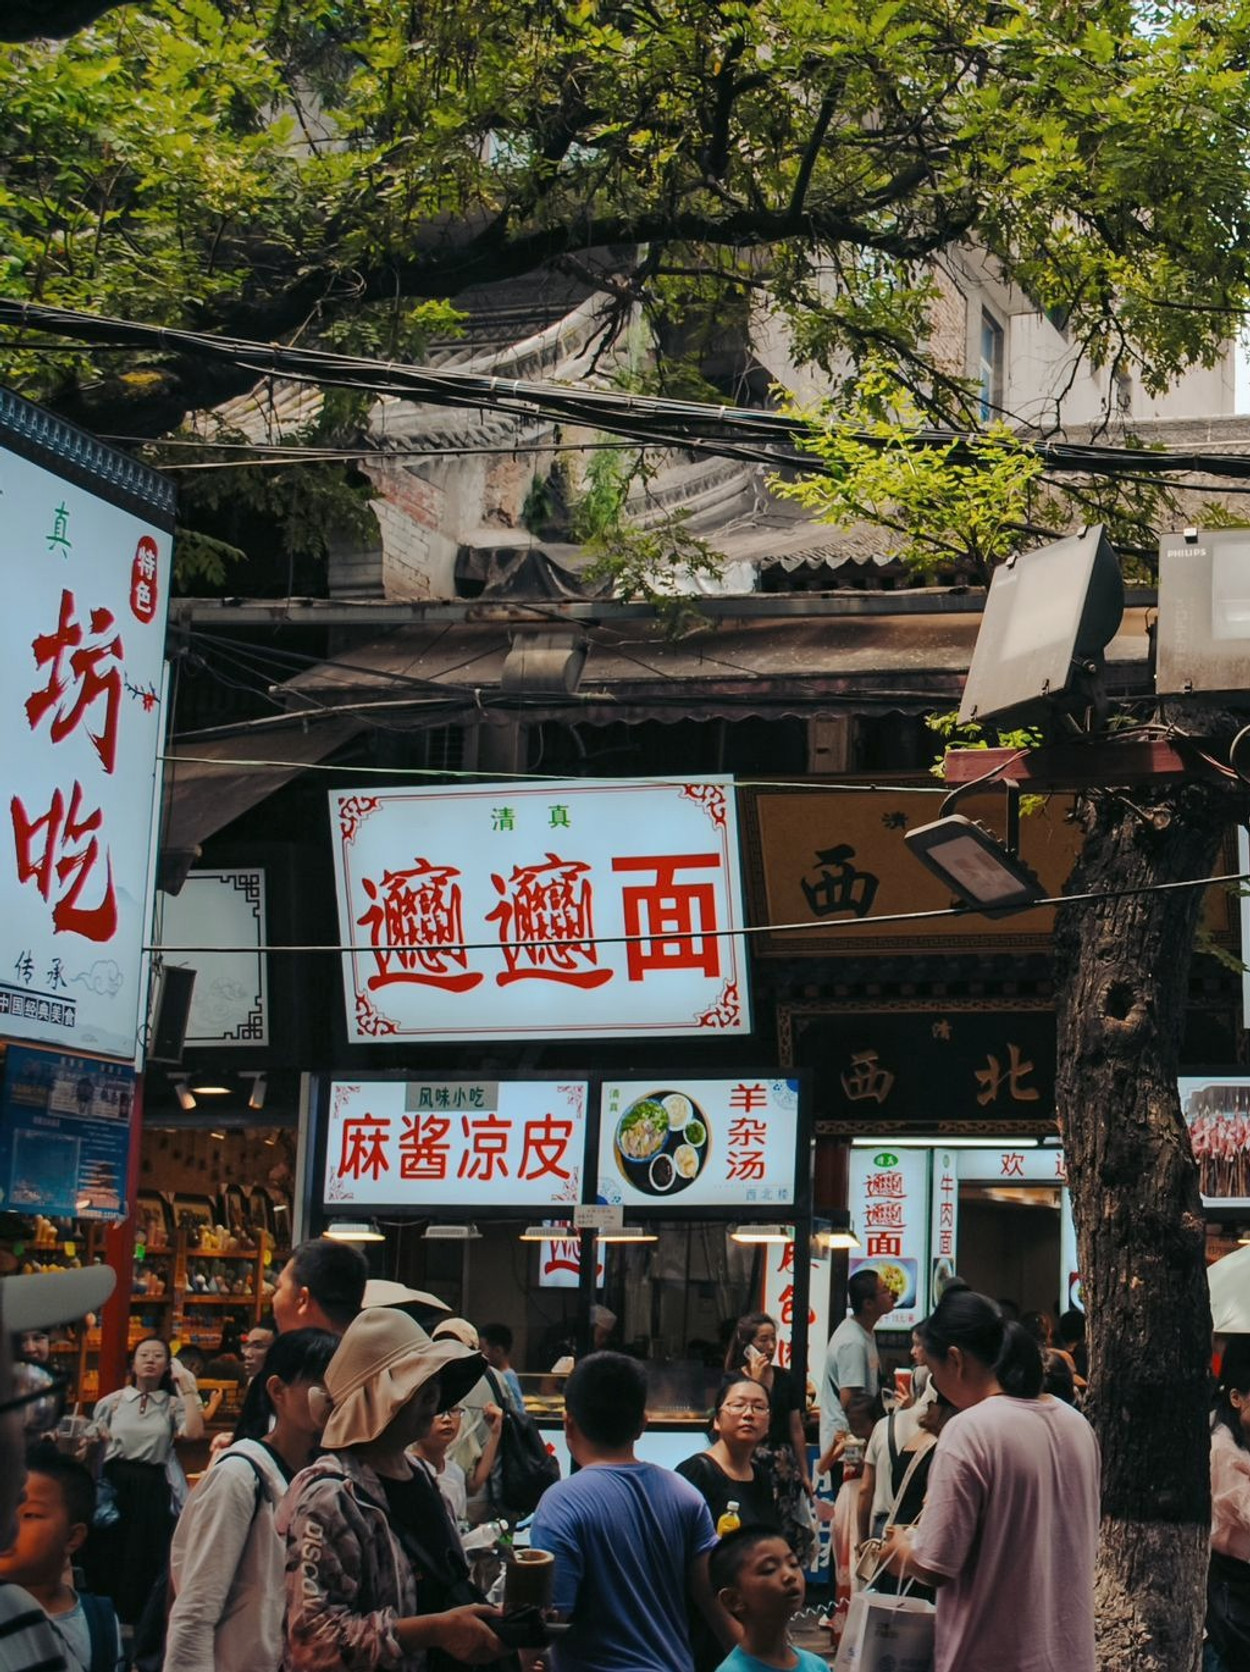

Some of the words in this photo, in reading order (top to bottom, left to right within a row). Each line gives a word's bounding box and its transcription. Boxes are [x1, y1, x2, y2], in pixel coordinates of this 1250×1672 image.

[46, 501, 72, 560] 真
[1167, 548, 1206, 558] PHILIPS
[136, 545, 157, 615] 特色
[491, 804, 572, 832] 清真
[10, 779, 118, 942] 吃
[801, 843, 880, 918] 西
[15, 949, 68, 990] 传承
[418, 1086, 486, 1108] 风味小吃
[841, 1042, 1040, 1106] 西北
[337, 1112, 575, 1181] 麻酱凉皮
[725, 1083, 768, 1181] 羊杂汤
[940, 1174, 954, 1255] 牛肉面
